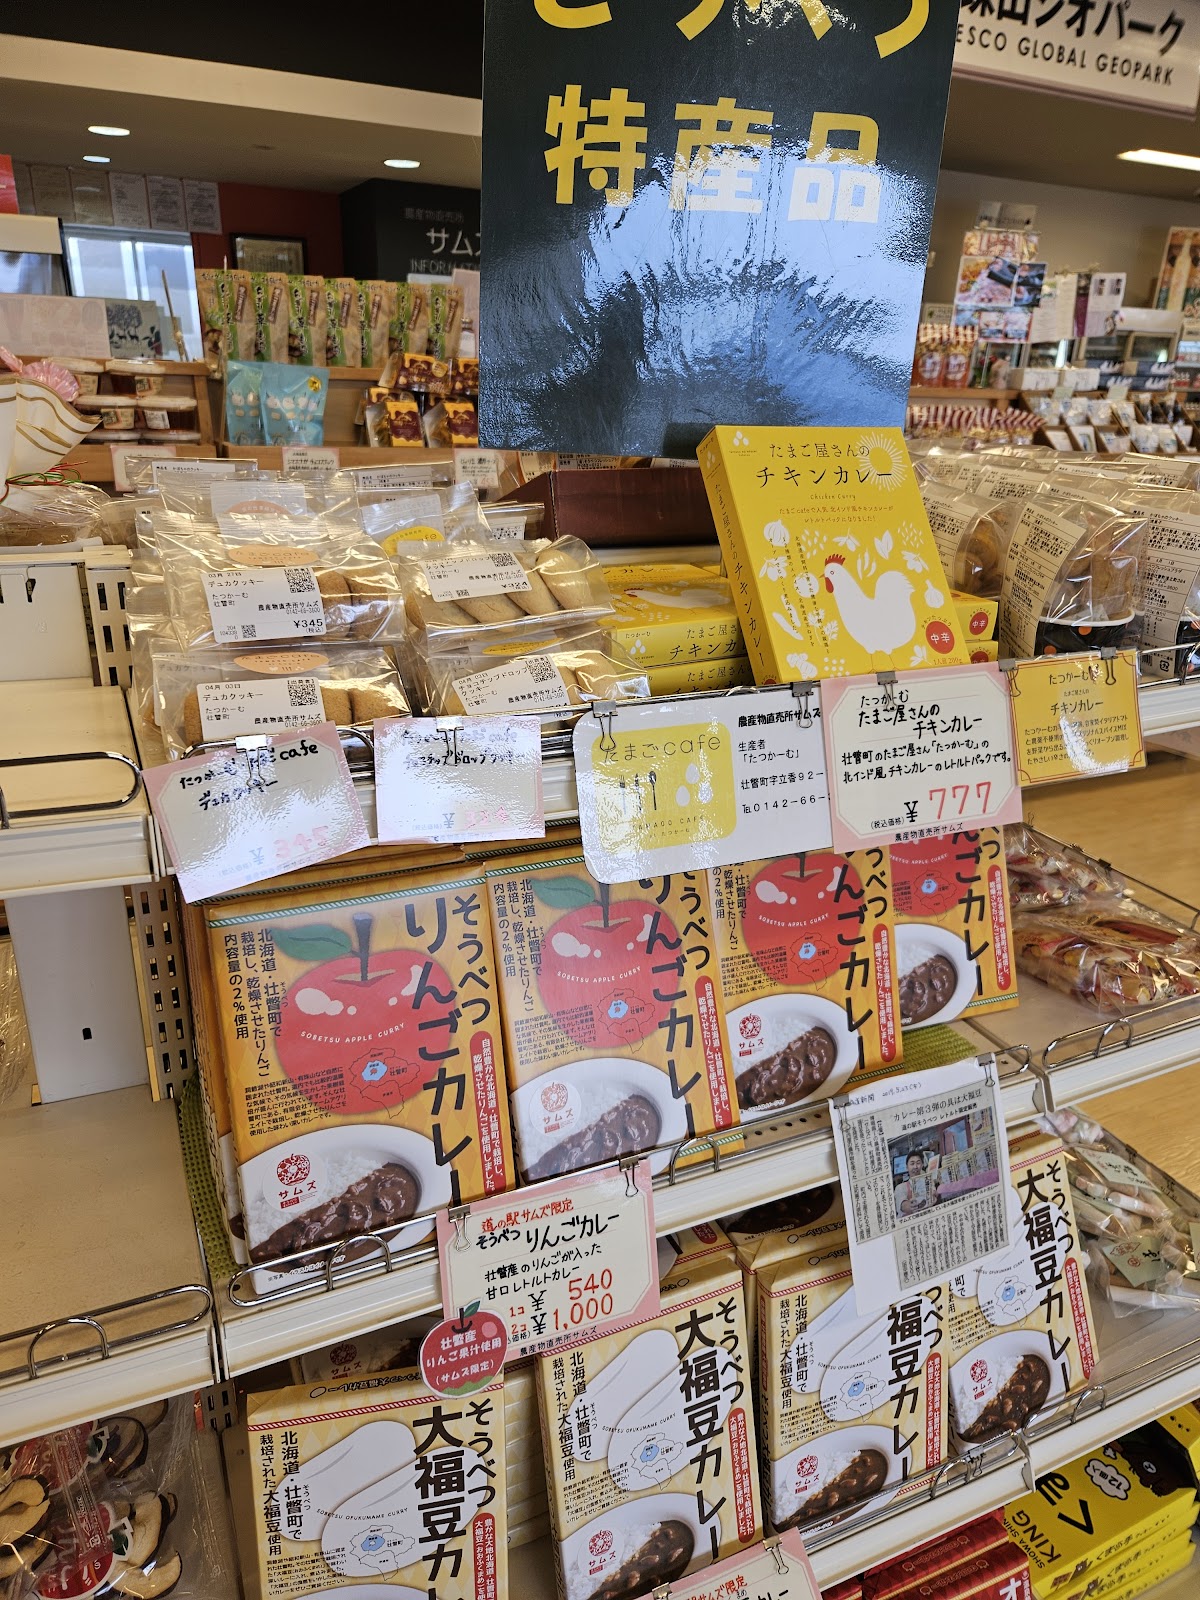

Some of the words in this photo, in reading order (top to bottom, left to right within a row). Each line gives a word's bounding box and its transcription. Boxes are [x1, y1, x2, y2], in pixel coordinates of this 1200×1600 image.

[1017, 36, 1087, 69] GLOBAL
[1095, 53, 1175, 86] GEOPARK
[544, 84, 881, 224] 特産品
[426, 227, 480, 256] サム
[769, 443, 870, 459] たまご屋さんの
[755, 465, 892, 489] チキンカレー
[208, 579, 265, 588] デュカクッキー
[212, 592, 249, 600] たつかーむ
[258, 600, 319, 611] 農産物直売所サムズ
[293, 618, 323, 629] ¥345
[686, 623, 742, 640] たまご屋さ
[930, 632, 950, 643] 中辛
[458, 666, 529, 691] チョコチップドロップ
[461, 684, 490, 697] クッキー
[1049, 670, 1089, 685] たつかーむ
[202, 691, 264, 702] デュカクッキー
[507, 685, 563, 704] 農産物直売所サムズ
[1050, 699, 1104, 716] チキンカレー
[205, 705, 245, 714] たつかーむ
[254, 713, 321, 725] 農産物直売所サムズ
[738, 707, 821, 728] 農産物直売所サムズ
[858, 704, 940, 727] たまご屋さんの
[912, 716, 983, 739] チキンカレー
[279, 739, 319, 761] cafe
[604, 734, 721, 762] たまごcafe
[738, 739, 766, 752] 生産者
[742, 750, 800, 764] 「たつかーむ」
[904, 800, 919, 823] ¥
[929, 781, 992, 820] 777
[442, 812, 455, 829] ¥
[870, 816, 905, 830] (税込価格)
[894, 822, 964, 842] 農産物直売所サムズ
[250, 846, 265, 865] ¥
[274, 825, 329, 859] 345
[712, 868, 725, 919] の2%使用
[493, 883, 517, 978] 内容量の2%使用
[520, 879, 542, 976] 北海道・壮瞥町で
[758, 914, 785, 927] SOBETSU
[810, 912, 829, 925] CURRY
[452, 893, 491, 1026] そうべつ
[506, 881, 535, 1012] 栽培し、乾燥させたりんご
[834, 850, 873, 1070] んごカレー
[224, 933, 249, 1040] 内容量の2%使用
[257, 928, 282, 1037] 北海道・壮瞥町で
[556, 970, 590, 983] SOBETSU
[593, 975, 616, 983] APPLE
[619, 965, 642, 980] CURRY
[240, 931, 271, 1078] 栽培し、乾燥させたりんご
[300, 1030, 340, 1043] SOBETSU
[344, 1033, 373, 1043] APPLE
[378, 1022, 406, 1038] CURRY
[738, 1037, 765, 1050] サムズ
[404, 897, 473, 1208] りんごカレー
[543, 1109, 574, 1125] サムズ
[893, 1088, 982, 1122] カレー第3弾の具は大福豆
[901, 1115, 938, 1131] 道の駅そうべつ
[278, 1180, 317, 1199] サムズ
[481, 1198, 574, 1234] 道の駅サムズ限定
[1046, 1159, 1074, 1254] そうべつ
[475, 1227, 521, 1250] そうべつ
[526, 1213, 620, 1253] りんごカレー
[484, 1242, 602, 1283] 壮瞥産のりんごが入った
[485, 1265, 580, 1301] 甘口レトルトカレー
[509, 1306, 525, 1318] 1コ
[528, 1289, 547, 1312] ¥
[568, 1268, 613, 1301] 540
[954, 1273, 967, 1298] 町で
[1017, 1168, 1071, 1393] 大福豆カレー
[511, 1323, 527, 1335] 2コ
[531, 1313, 547, 1335] ¥
[553, 1293, 613, 1331] 1,000
[426, 1337, 502, 1368] りんご果汁使用
[440, 1329, 477, 1350] 壮瞥産
[519, 1325, 597, 1357] 農産物直売所サムズ
[715, 1296, 744, 1405] そうべつ
[795, 1294, 809, 1392] 北海道・壮瞥町で
[780, 1298, 793, 1410] 栽培された大福豆使用
[436, 1359, 495, 1386] (サムズ限定)
[972, 1379, 993, 1393] サムズ
[887, 1293, 924, 1480] 福豆カレー
[552, 1357, 576, 1482] 栽培された大福豆使用
[569, 1351, 593, 1461] 北海道・壮瞥町で
[590, 1402, 598, 1430] そうべつ
[660, 1413, 676, 1425] CURRY
[675, 1309, 727, 1560] 大福豆カレー
[465, 1398, 497, 1508] そうべつ
[280, 1431, 303, 1540] 北海道・壮瞥町で
[795, 1475, 820, 1487] サムズ
[1092, 1468, 1126, 1492] 12個入
[259, 1434, 282, 1556] 栽培された大福豆使用
[302, 1484, 311, 1511] そうべつ
[316, 1508, 343, 1520] SOBETSU
[387, 1507, 409, 1518] CURRY
[1011, 1510, 1063, 1564] KING
[589, 1551, 616, 1567] サムズ
[1018, 1535, 1046, 1569] SHOWA
